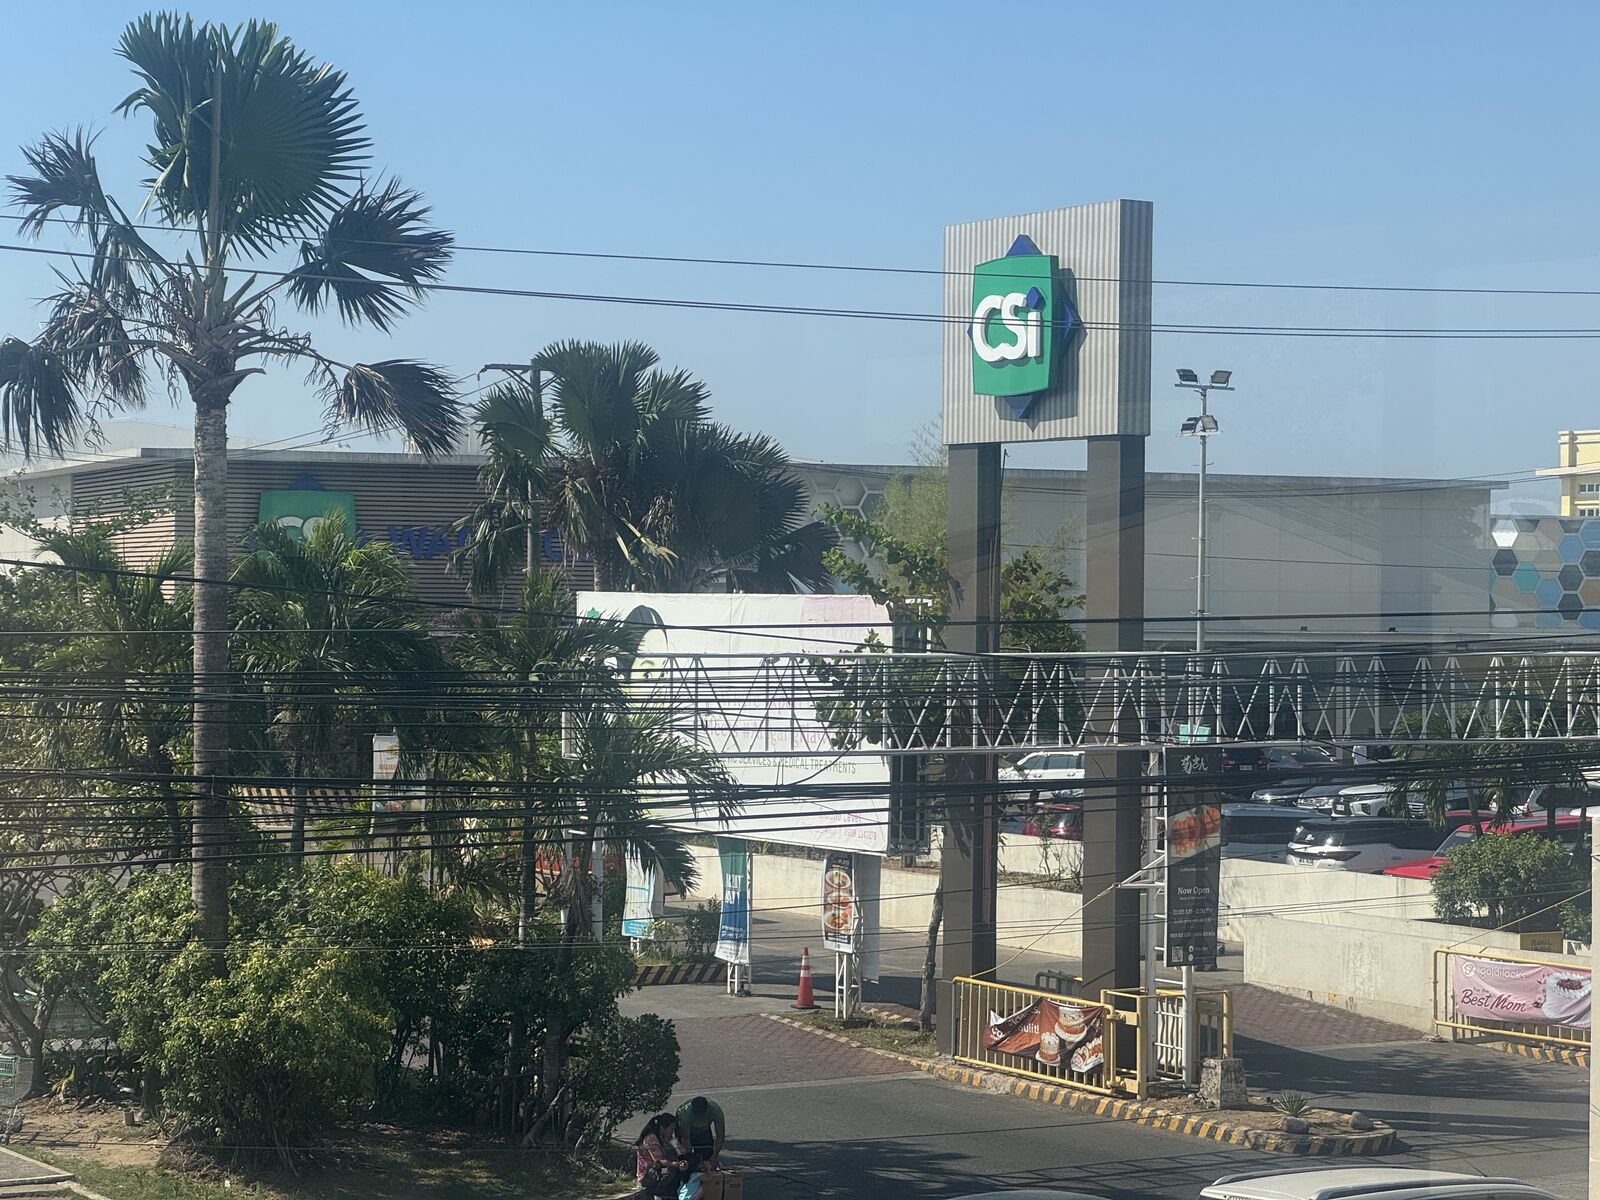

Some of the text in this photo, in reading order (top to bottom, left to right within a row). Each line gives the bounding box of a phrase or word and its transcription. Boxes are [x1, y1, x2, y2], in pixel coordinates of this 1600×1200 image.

[779, 756, 809, 770] MEDICAL
[810, 758, 857, 774] TREATMENTS
[1177, 886, 1210, 895] Now Open
[1461, 989, 1527, 1012] Best Mom
